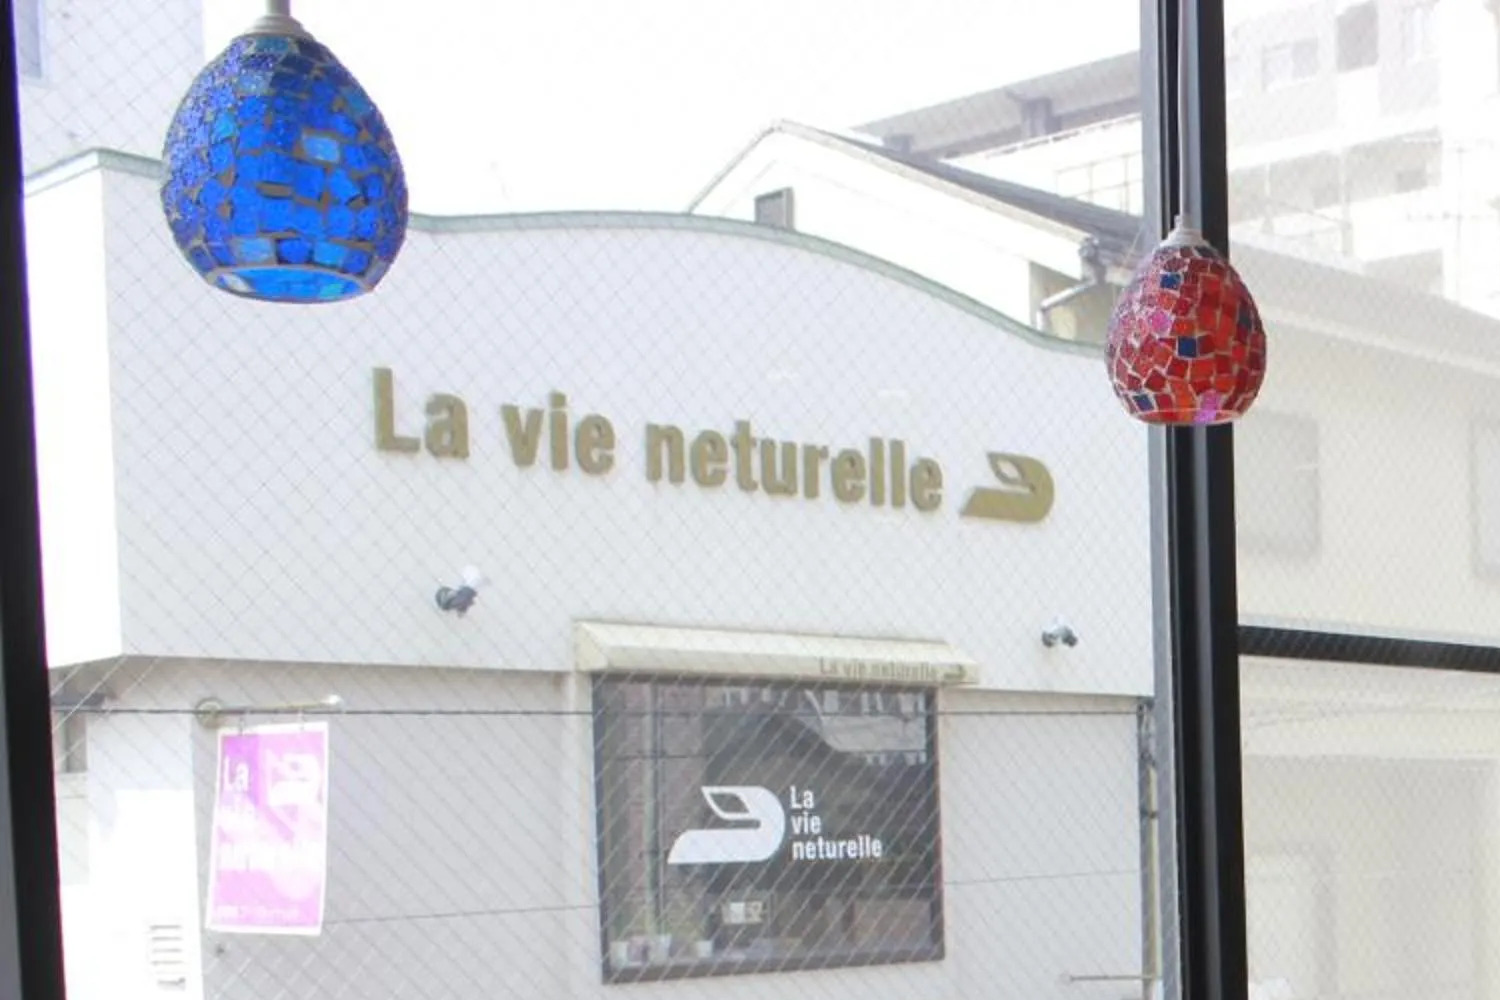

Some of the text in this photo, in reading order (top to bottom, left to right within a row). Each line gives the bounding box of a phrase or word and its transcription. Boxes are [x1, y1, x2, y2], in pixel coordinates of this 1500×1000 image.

[371, 366, 943, 513] La vie neturelle
[790, 785, 815, 809] La
[790, 810, 821, 834] vie
[792, 834, 882, 860] neturelle
